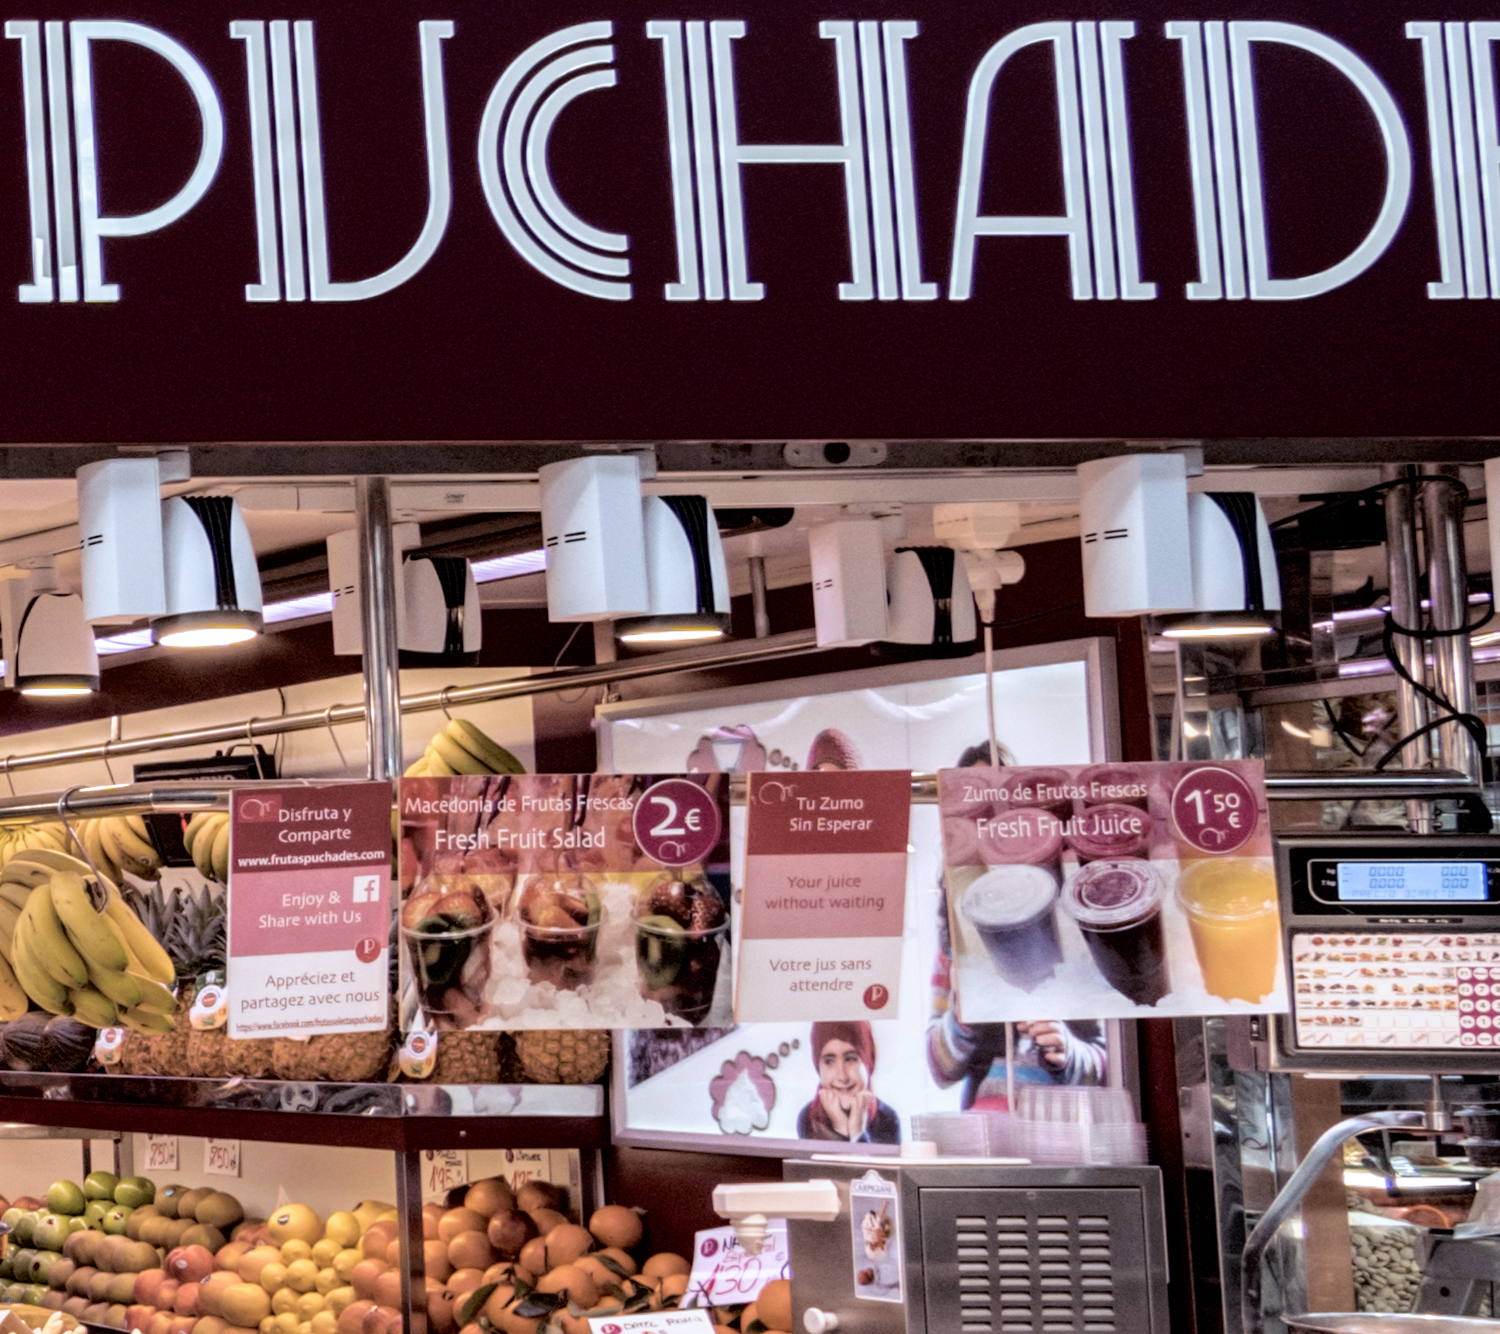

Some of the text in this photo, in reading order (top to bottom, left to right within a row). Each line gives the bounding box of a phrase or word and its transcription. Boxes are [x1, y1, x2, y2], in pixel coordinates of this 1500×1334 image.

[962, 780, 1149, 803] Zumo de Frutas Frescas
[405, 793, 634, 815] Macedonia de Frutas Frescas
[796, 795, 864, 811] Tu Zumo
[278, 806, 352, 825] Disfruta y
[789, 816, 873, 835] Sin Esperar
[976, 812, 1143, 839] Fresh Fruit Juice
[278, 826, 352, 846] Comparte
[434, 826, 606, 851] Fresh Fruit Salad
[237, 848, 386, 868] www.frutaspuchades.com
[787, 873, 861, 891] Your juice
[281, 891, 341, 912] Enjoy &
[764, 893, 885, 914] without waiting
[258, 909, 362, 930] Share with Us
[769, 956, 873, 975] Votre jus sans
[265, 970, 356, 990] Appréciez et
[788, 976, 854, 993] attendre
[240, 990, 380, 1014] partagez avec nous
